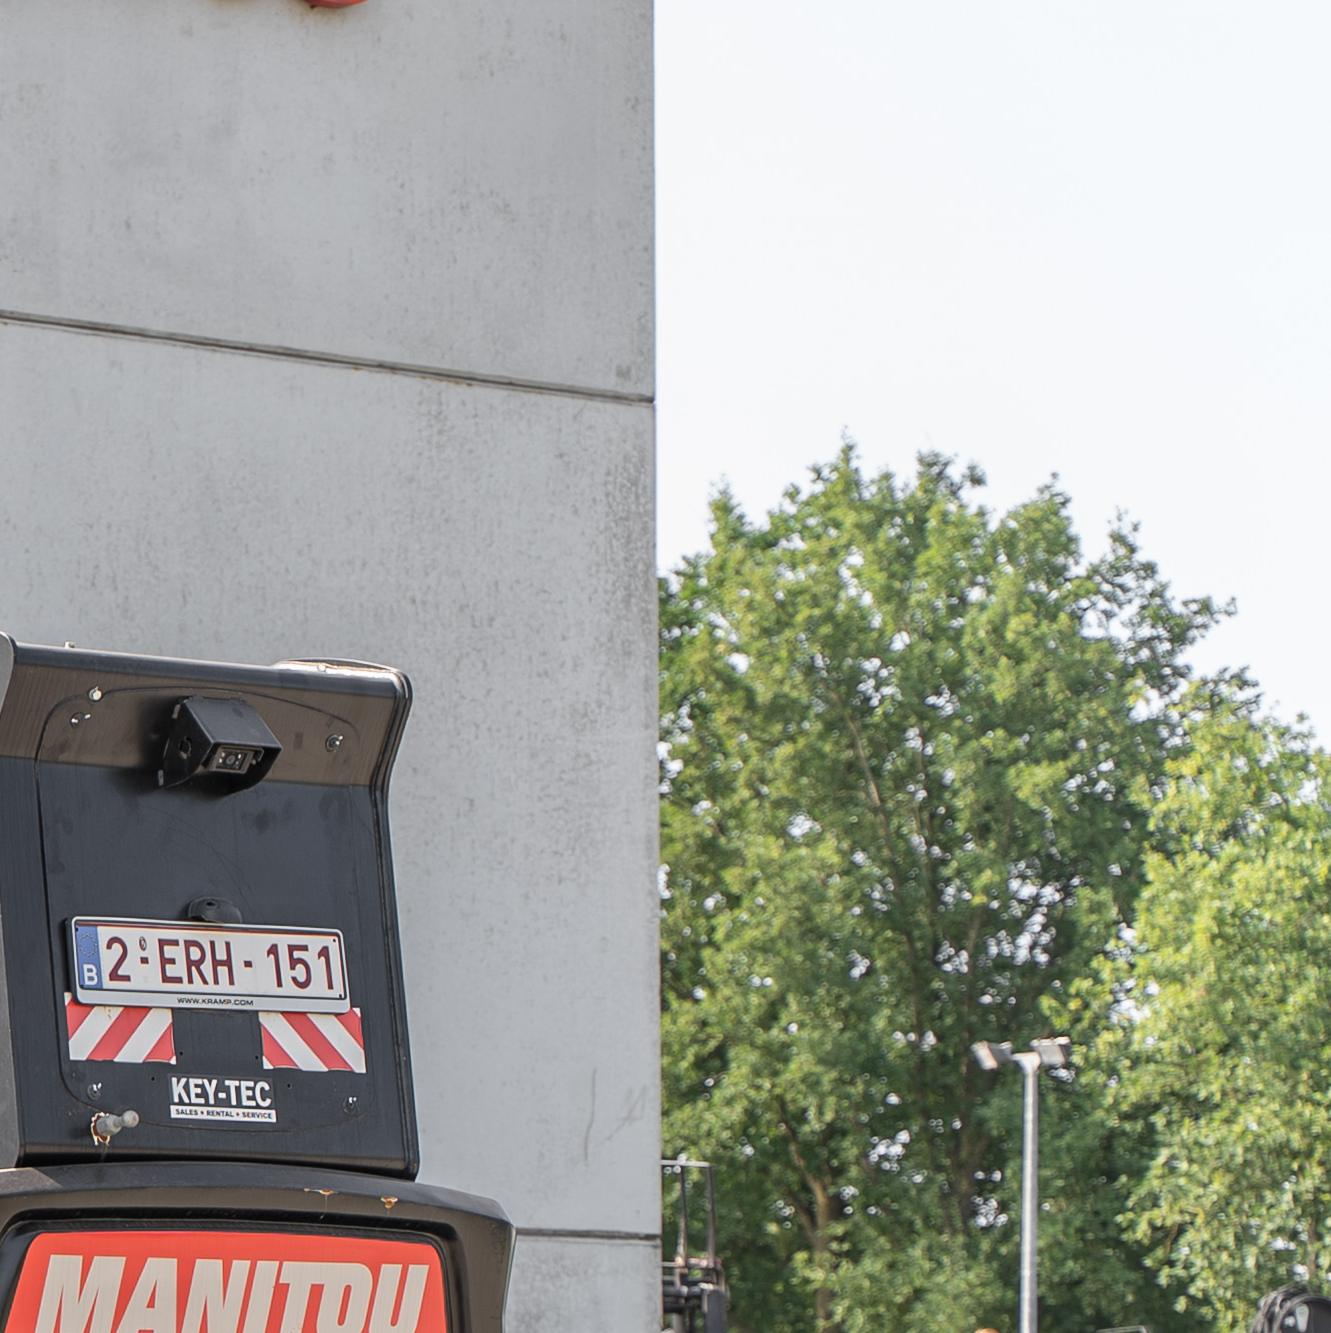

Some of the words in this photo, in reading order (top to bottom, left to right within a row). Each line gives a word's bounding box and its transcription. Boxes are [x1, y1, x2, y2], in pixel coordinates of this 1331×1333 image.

[83, 963, 98, 986] B
[177, 997, 254, 1006] WWW.KRAMP.COM
[171, 1077, 272, 1107] KEY-TEC
[175, 1108, 198, 1116] SALES
[242, 1111, 272, 1119] SERVICE
